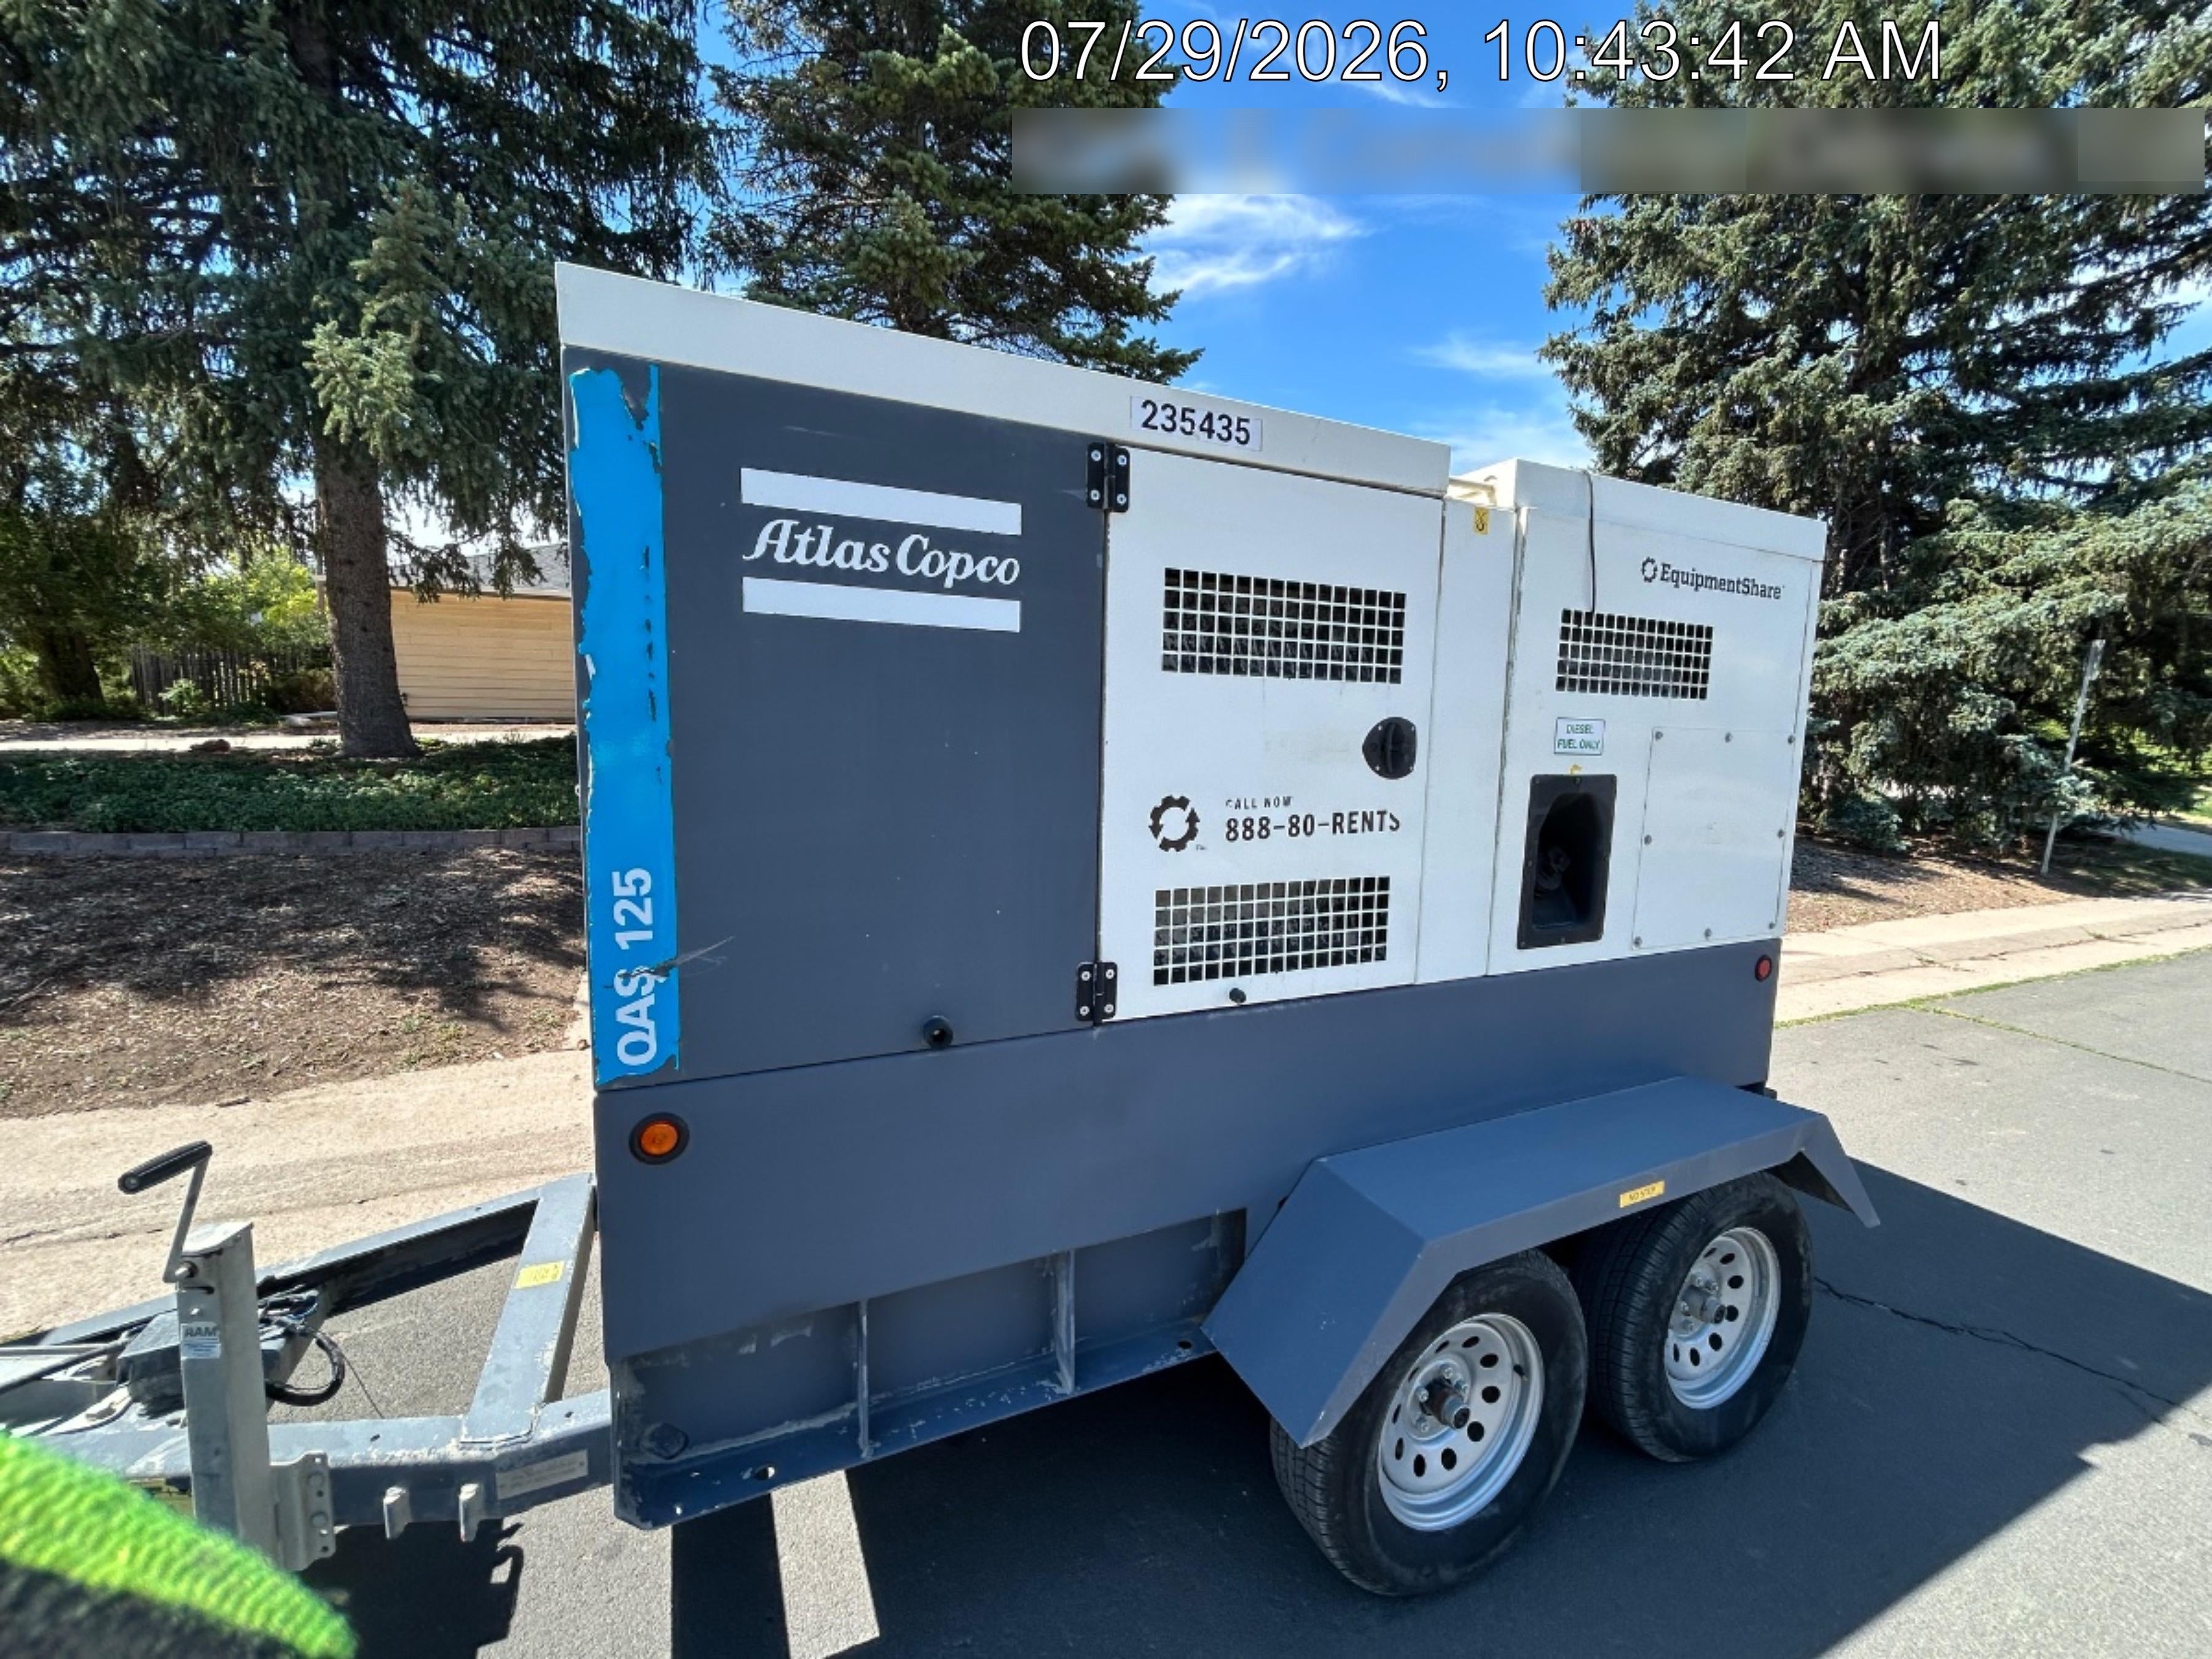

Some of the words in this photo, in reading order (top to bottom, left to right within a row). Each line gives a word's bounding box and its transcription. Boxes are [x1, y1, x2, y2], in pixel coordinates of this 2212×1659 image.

[1141, 399, 1250, 445] 235435
[742, 519, 891, 573] Atlas
[896, 534, 1021, 589] Copco
[1660, 562, 1781, 600] EquipmentShare
[1264, 796, 1292, 808] NOW
[1225, 810, 1400, 842] 888-80-RENTS
[612, 868, 653, 950] 125
[614, 965, 657, 1066] QAS
[185, 1327, 218, 1337] RAM
